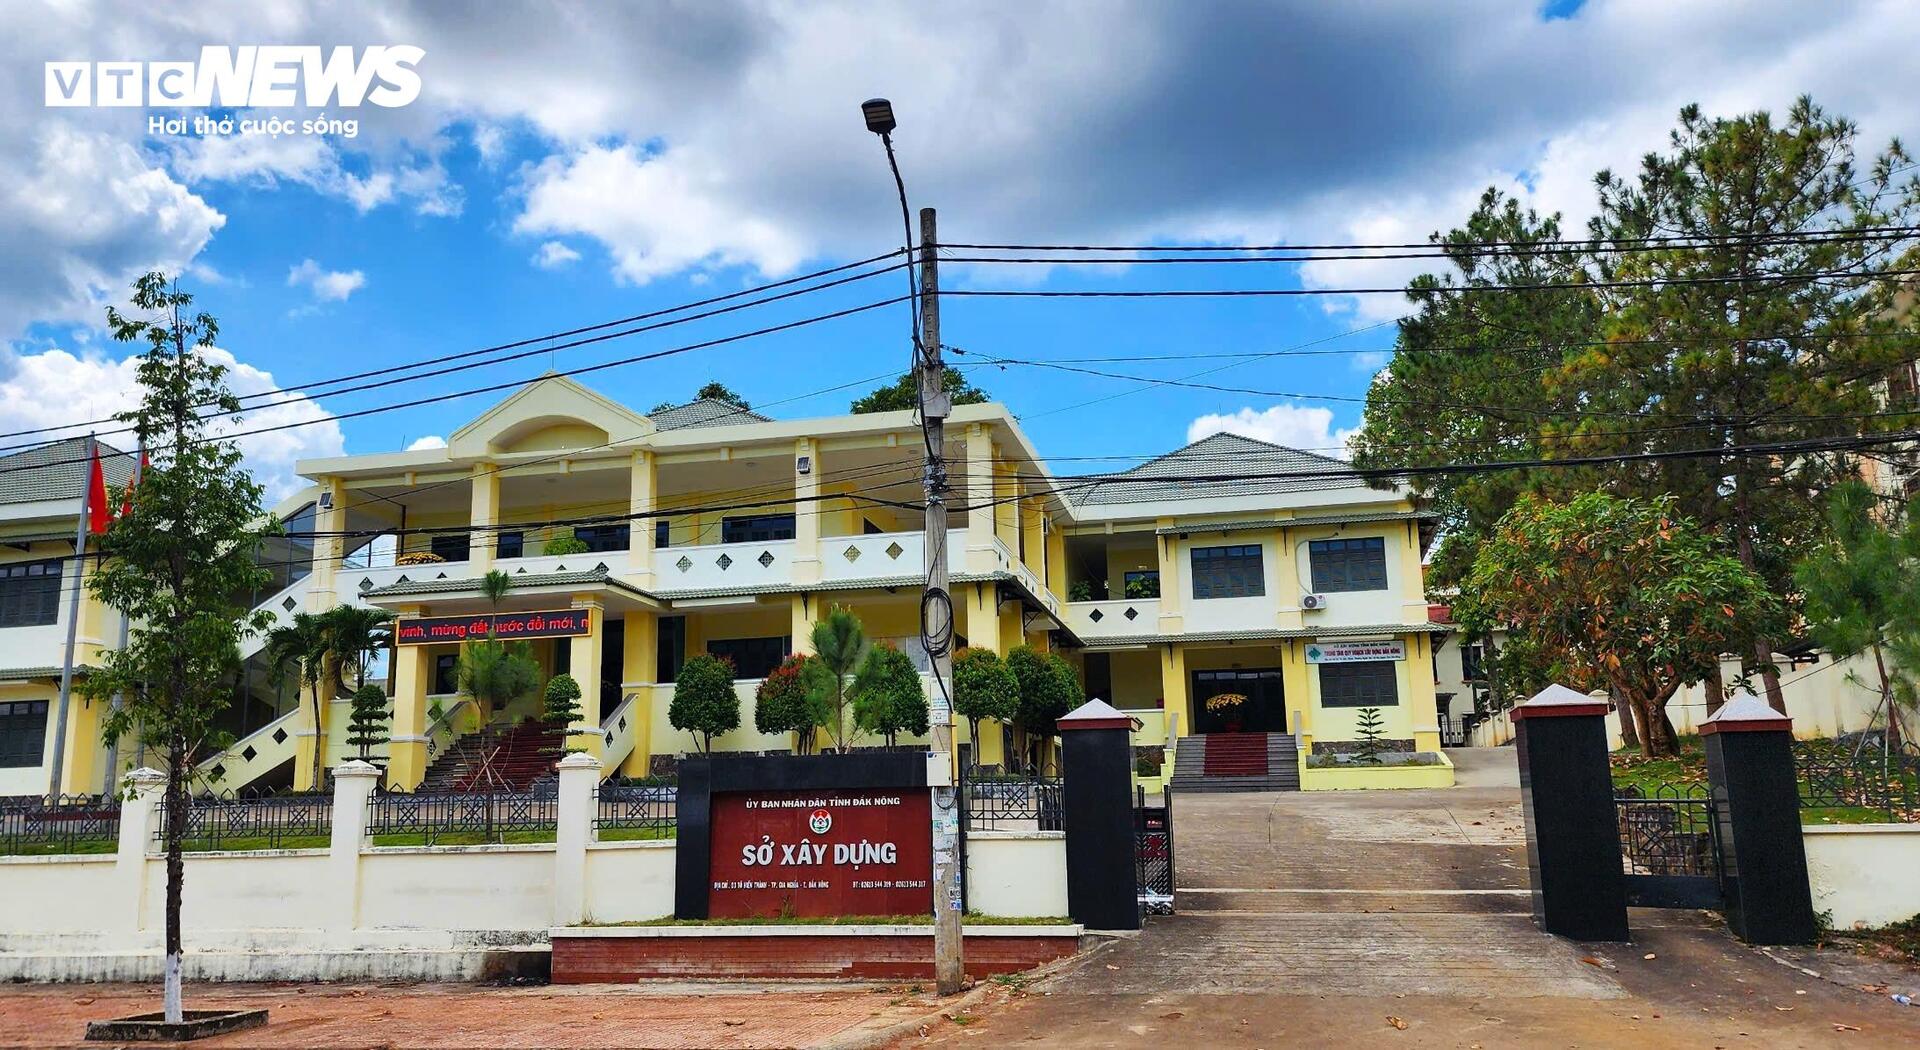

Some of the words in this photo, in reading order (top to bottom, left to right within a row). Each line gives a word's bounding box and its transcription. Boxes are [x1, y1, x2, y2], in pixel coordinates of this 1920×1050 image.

[431, 623, 466, 637] mừng
[469, 618, 488, 634] đất
[746, 798, 759, 808] ỦY
[761, 800, 780, 808] BAN
[781, 798, 806, 808] NHÂN
[808, 797, 826, 808] DÂN
[828, 796, 851, 807] TỈNH
[874, 795, 900, 806] NÔNG
[742, 835, 775, 866] SỞ
[780, 838, 828, 865] XÂY
[834, 839, 897, 870] DỰNG
